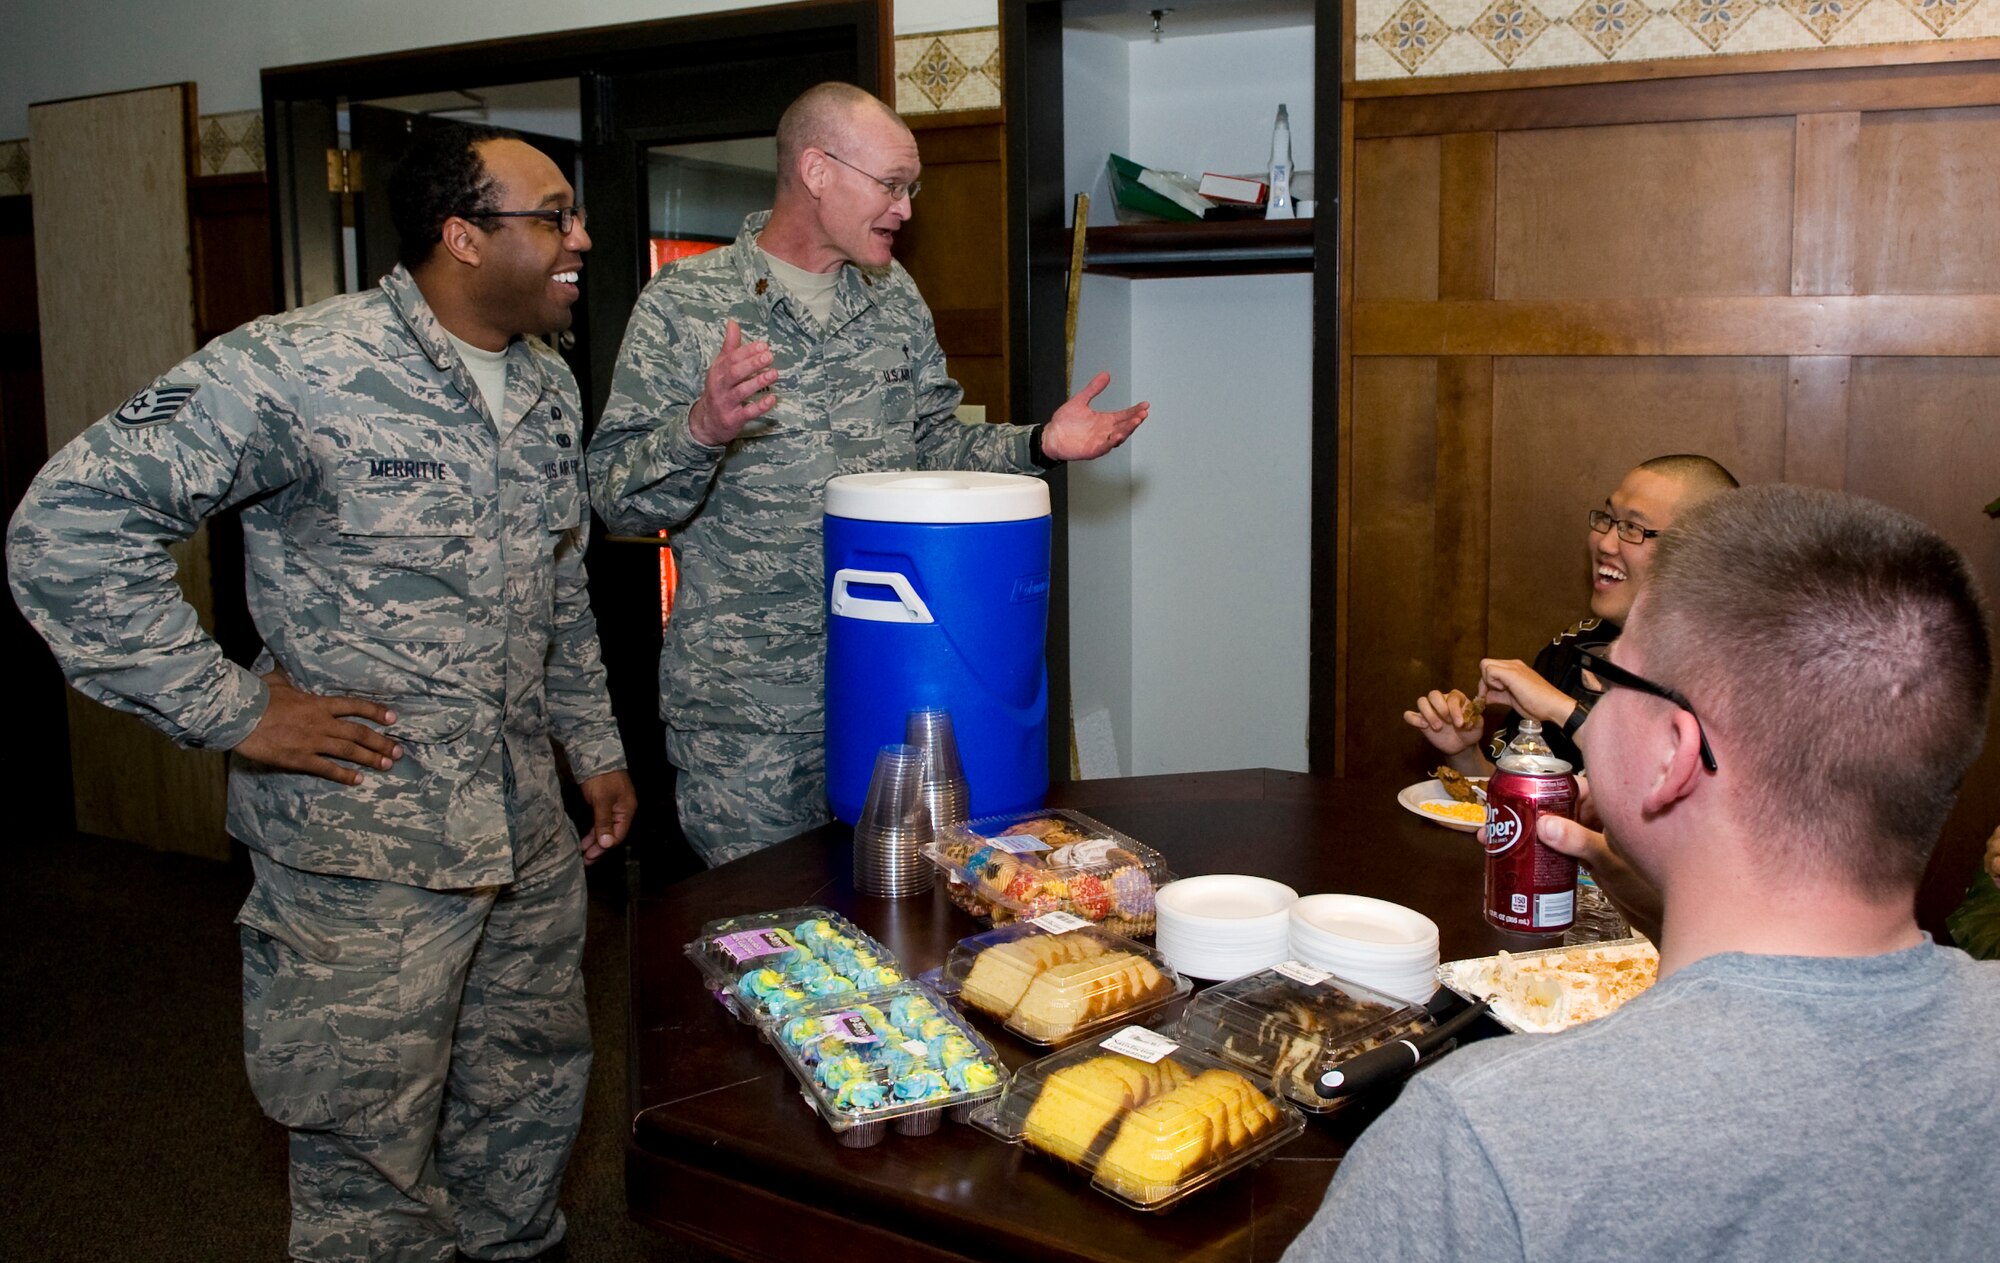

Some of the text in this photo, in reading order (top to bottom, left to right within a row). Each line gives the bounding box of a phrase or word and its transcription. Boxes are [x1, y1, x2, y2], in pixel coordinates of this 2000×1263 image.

[369, 459, 446, 480] MERRITTE
[545, 463, 558, 479] US
[1513, 896, 1526, 904] 150
